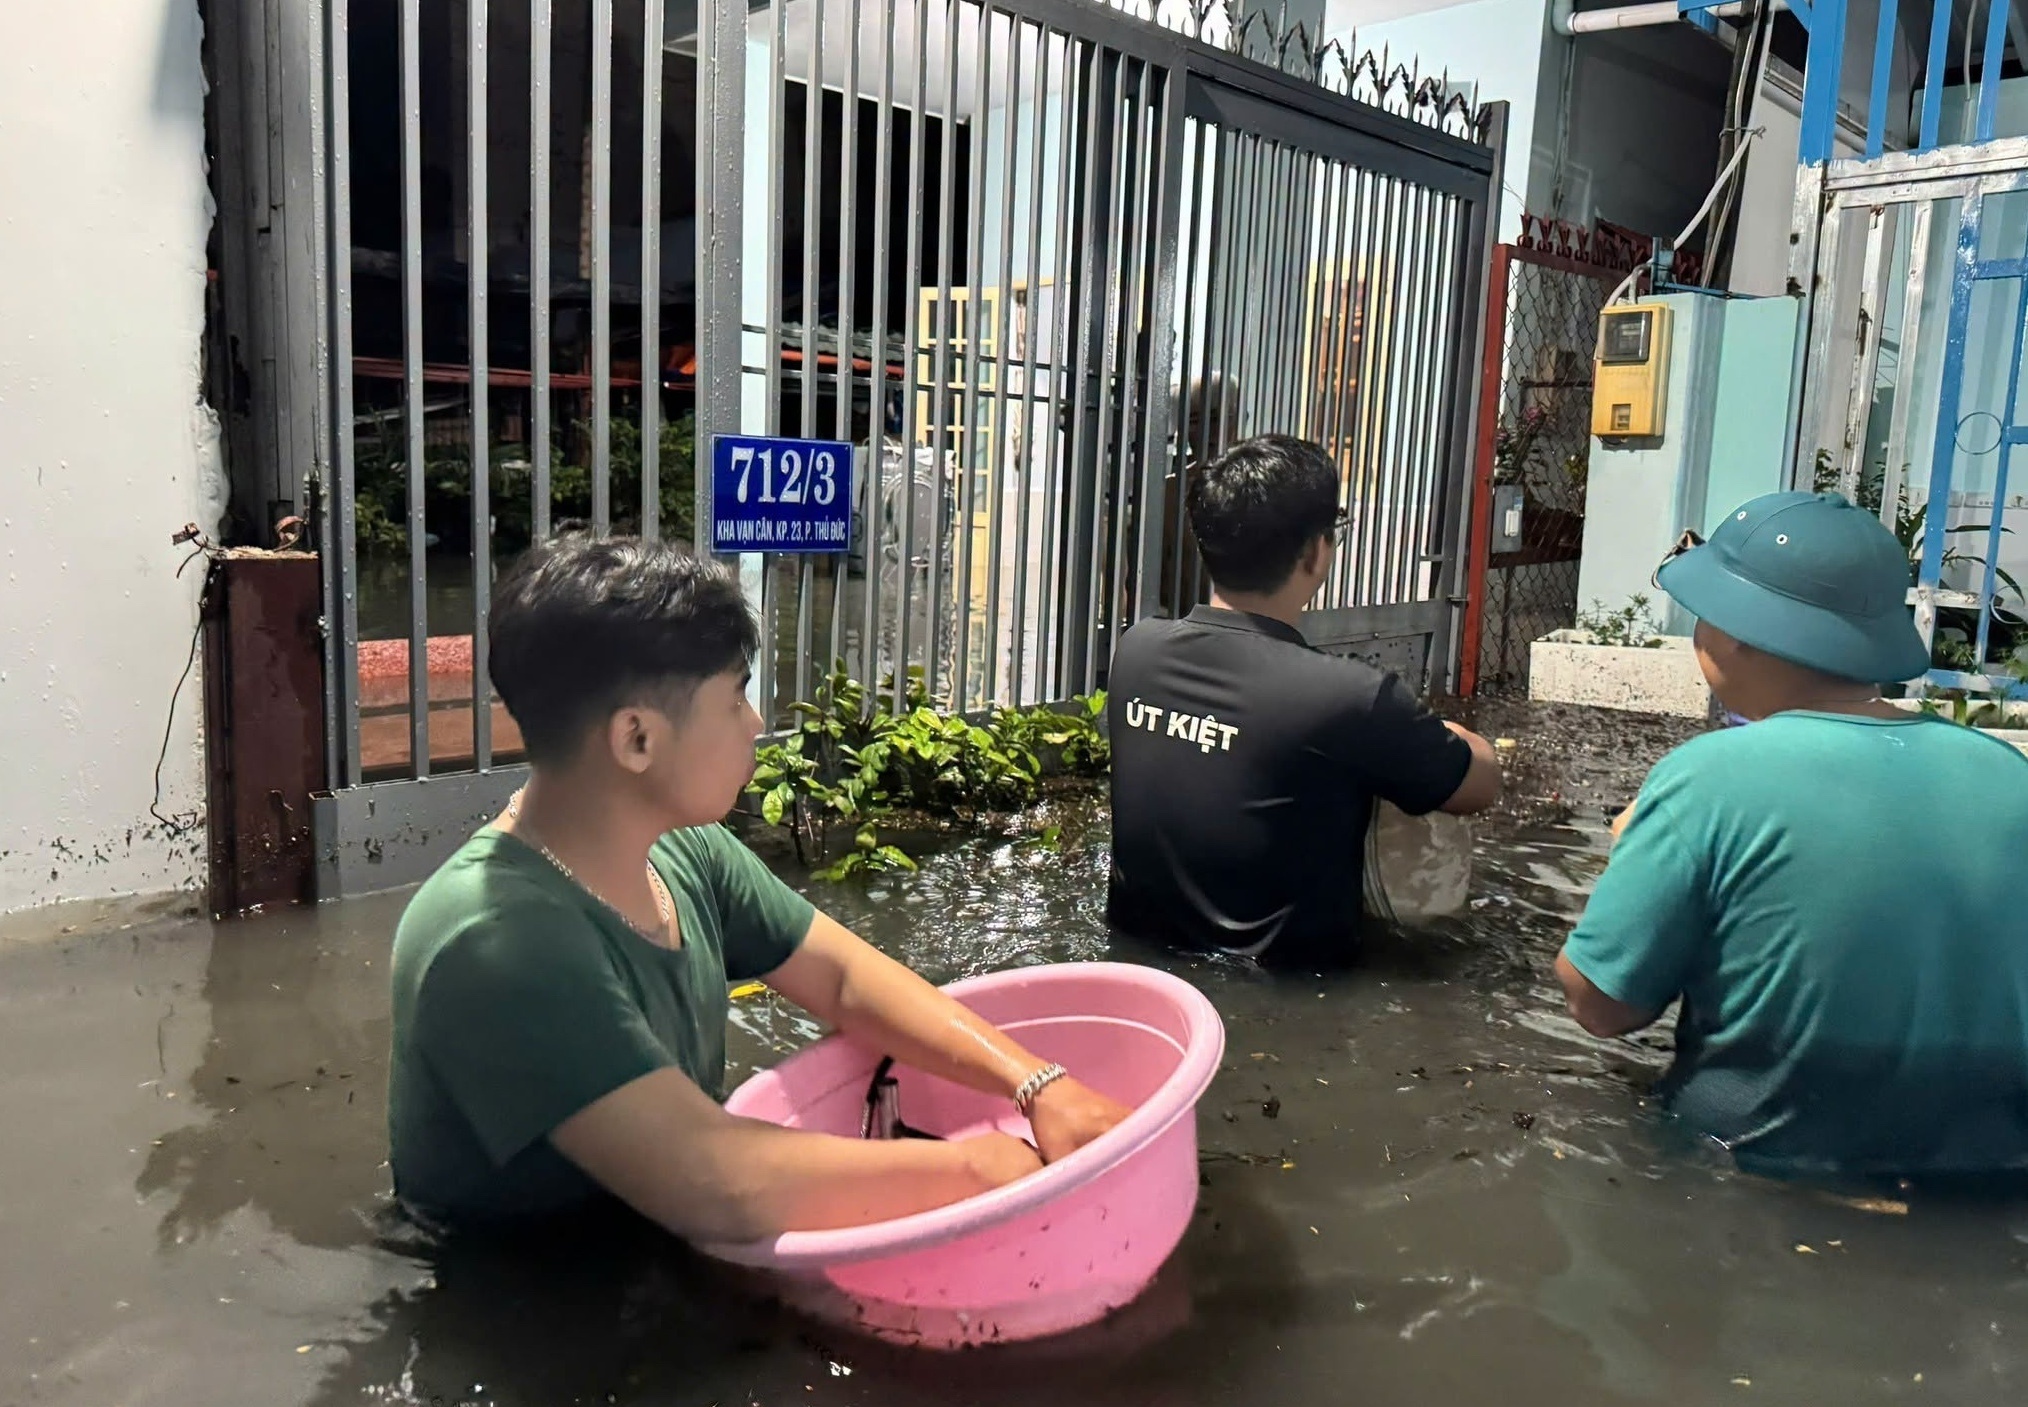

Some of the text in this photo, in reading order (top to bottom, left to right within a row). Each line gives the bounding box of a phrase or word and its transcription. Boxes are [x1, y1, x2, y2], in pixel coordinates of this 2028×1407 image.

[731, 446, 835, 505] 712/3
[717, 519, 735, 541] KHA
[736, 519, 754, 545] VẠN
[776, 520, 789, 541] KP.
[791, 520, 804, 543] 23,
[805, 520, 812, 541] P.
[814, 515, 829, 541] THỦ
[830, 517, 846, 541] ĐỨC
[1126, 697, 1239, 754] ÚT KIỆT
